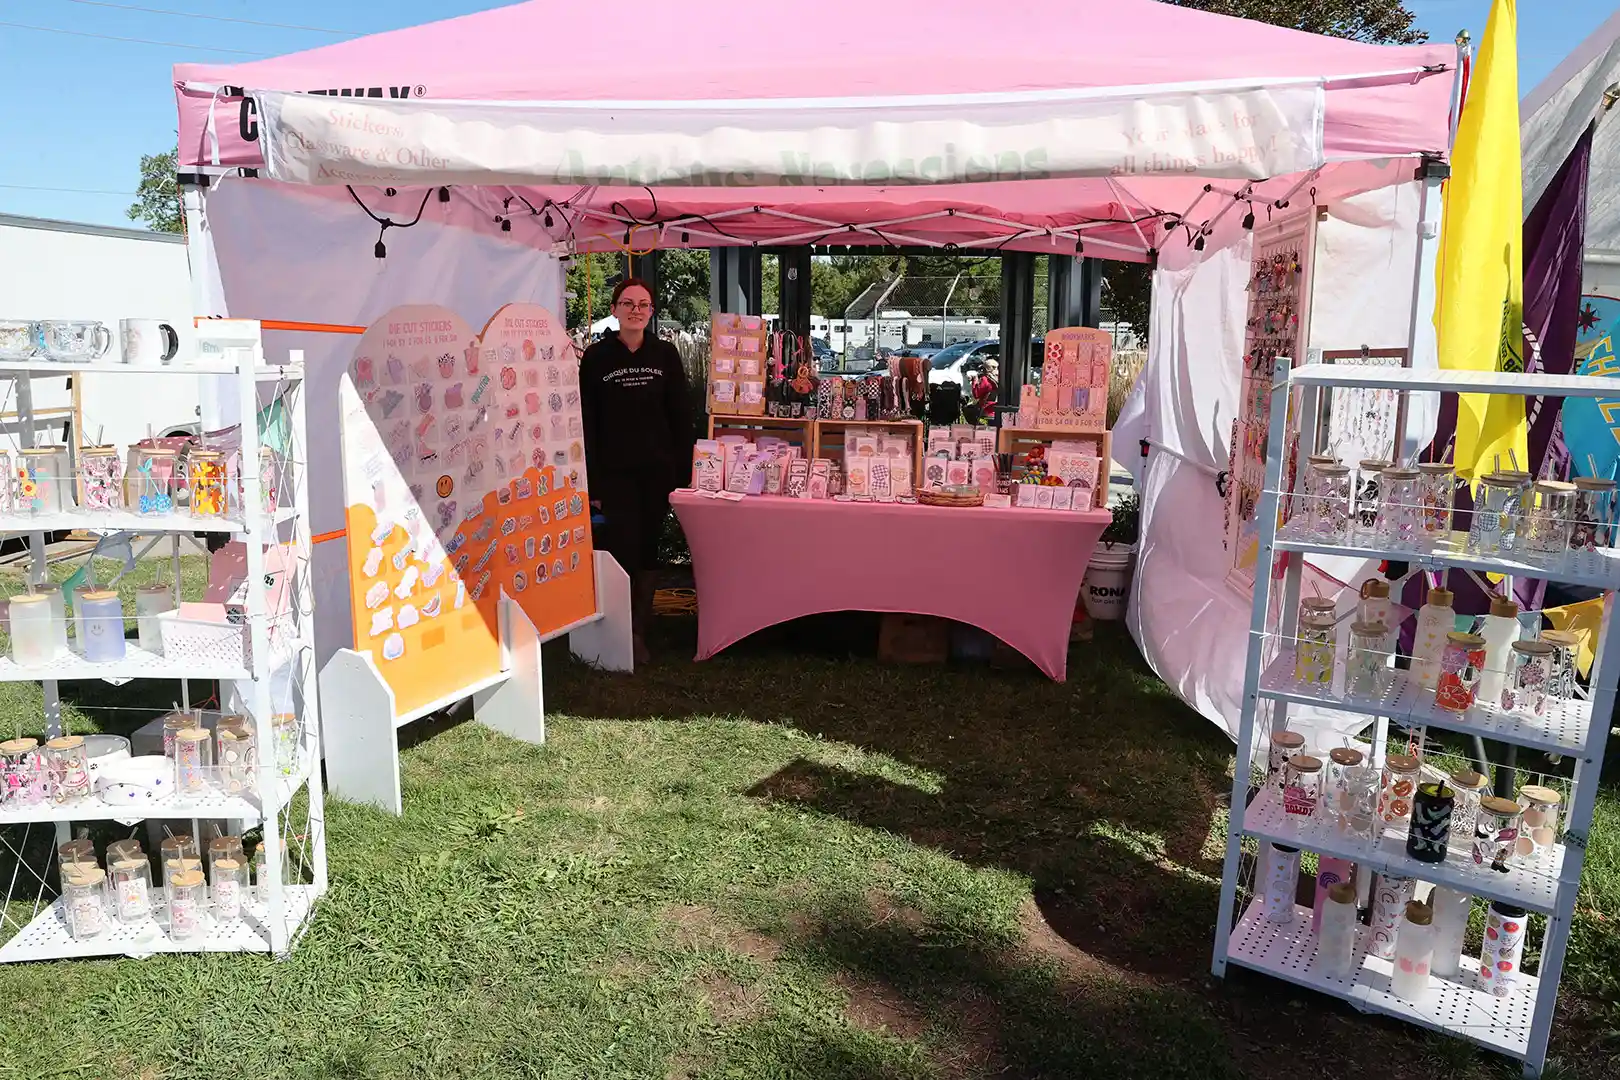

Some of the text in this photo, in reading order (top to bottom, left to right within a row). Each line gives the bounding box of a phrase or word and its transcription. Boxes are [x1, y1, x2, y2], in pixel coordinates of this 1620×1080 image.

[1233, 111, 1261, 127] for
[376, 147, 392, 163] &
[396, 146, 451, 170] Other
[1110, 155, 1137, 174] all
[388, 319, 453, 335] DIE CUT STICKERS
[602, 367, 628, 382] CIRQUE
[640, 367, 664, 376] SOLEIL
